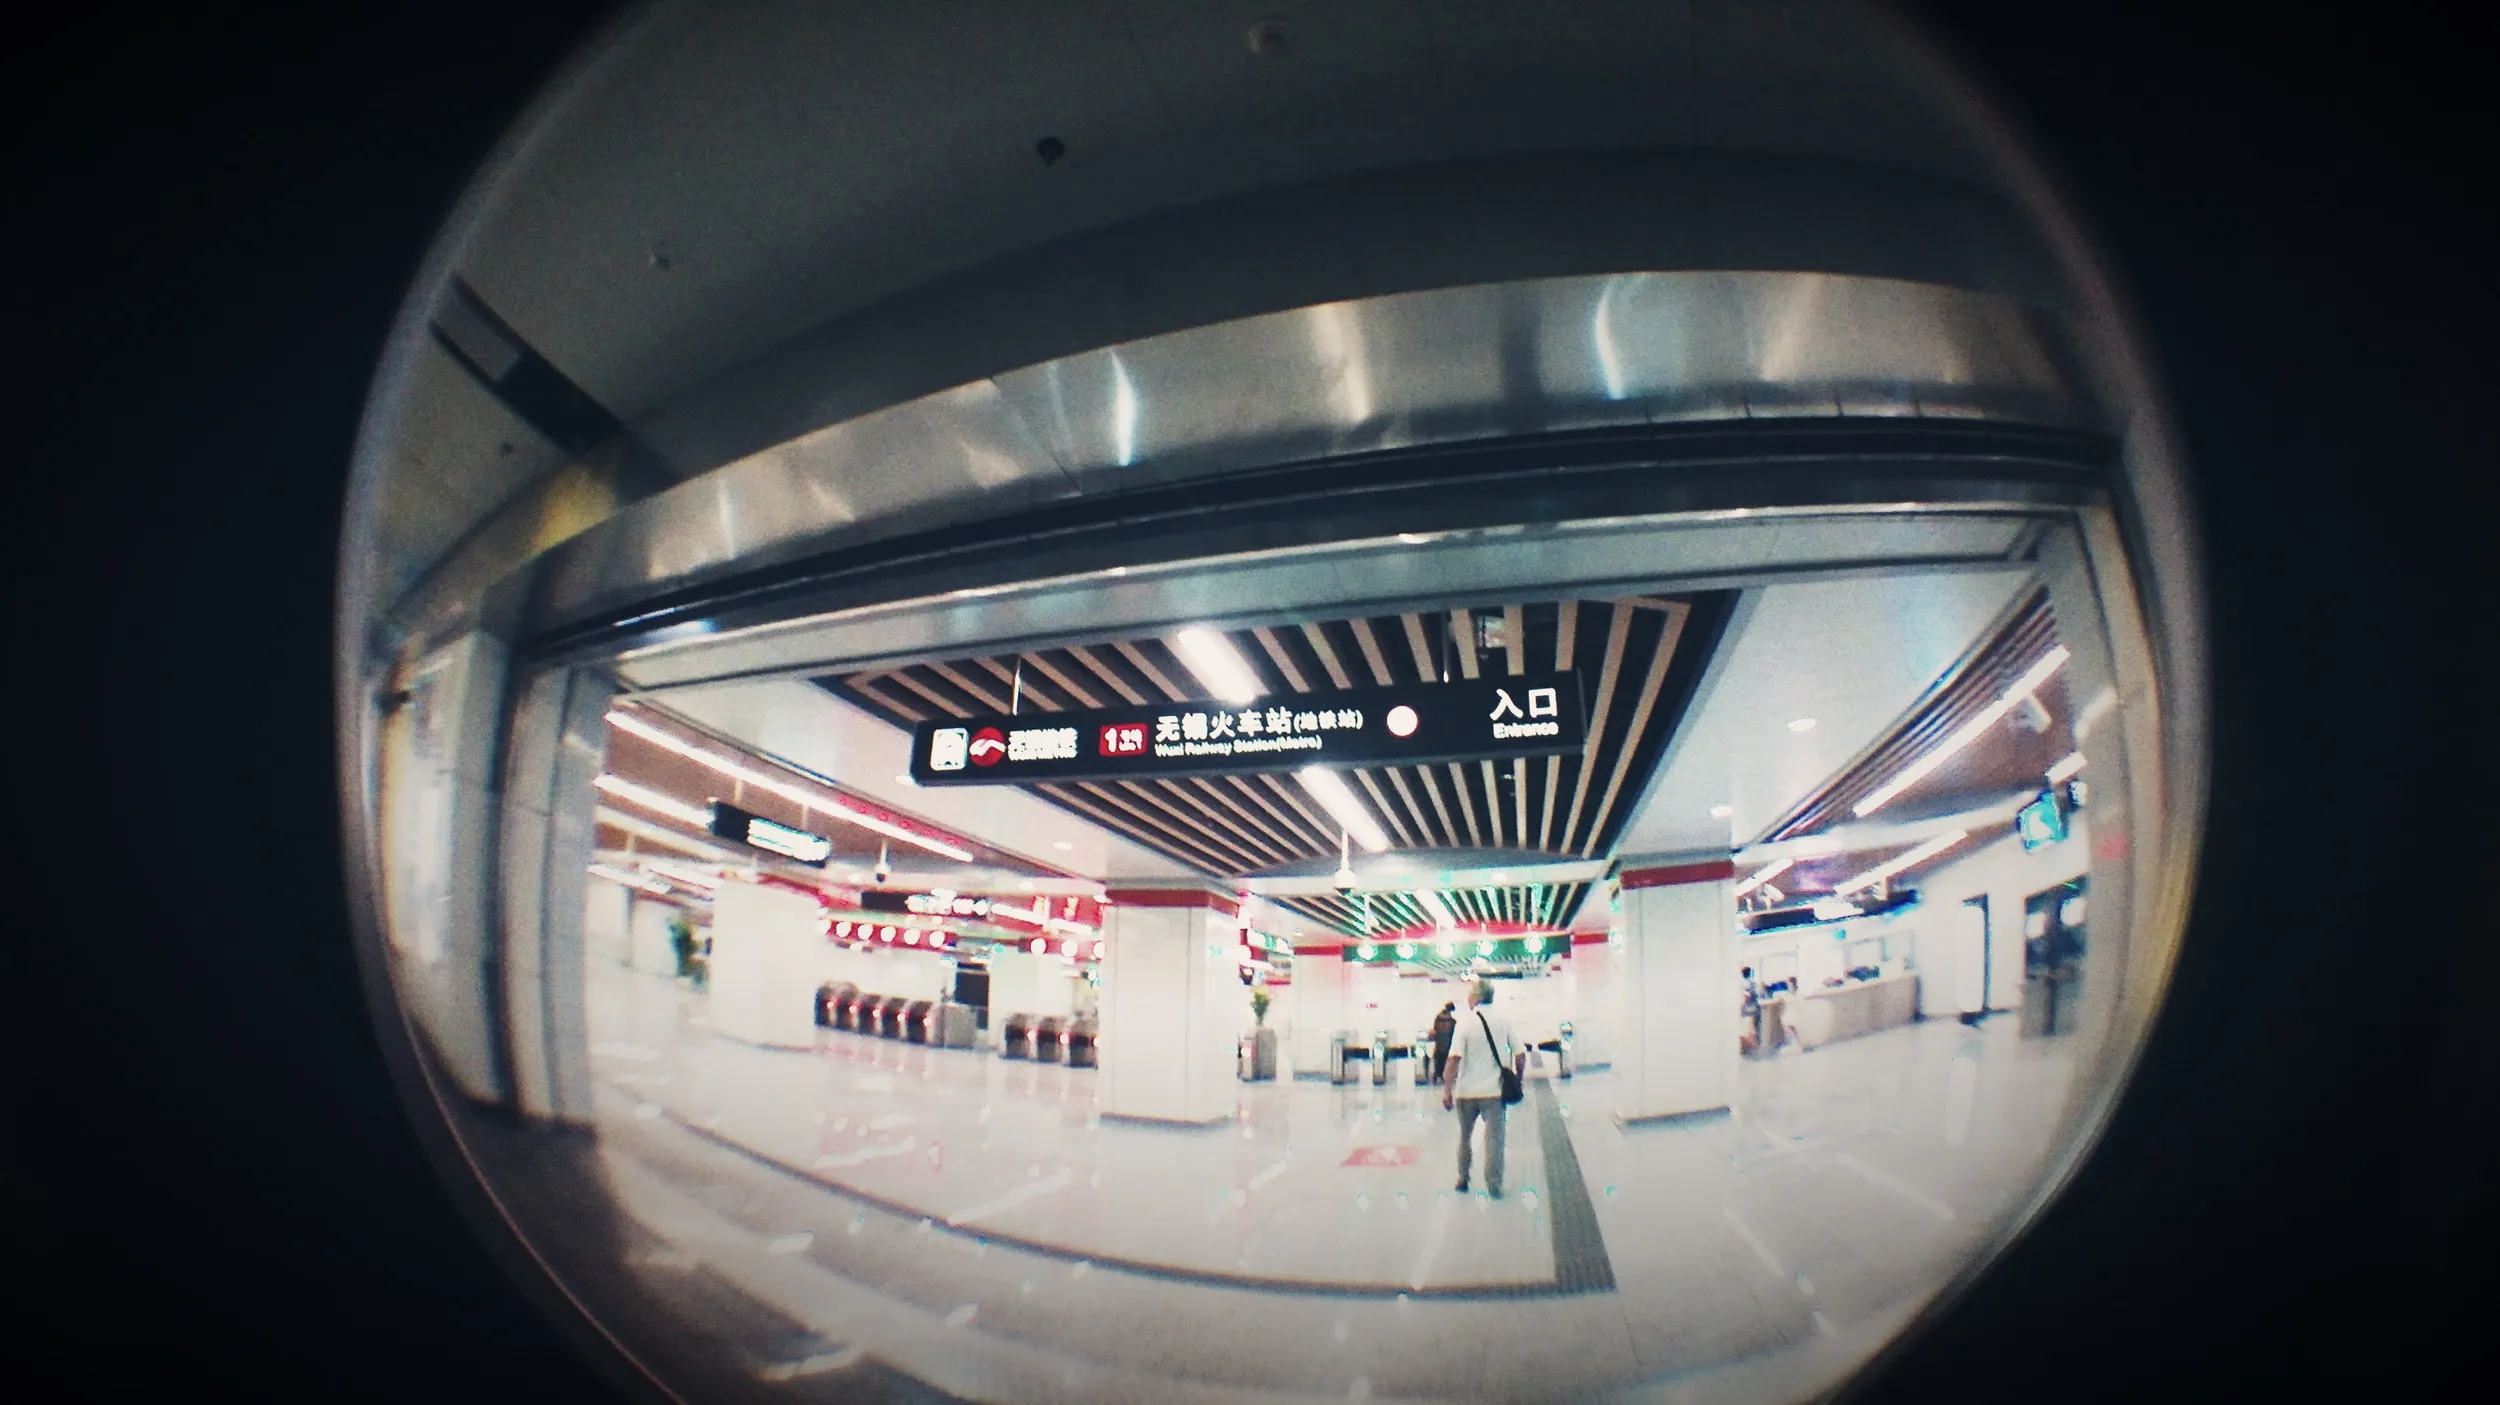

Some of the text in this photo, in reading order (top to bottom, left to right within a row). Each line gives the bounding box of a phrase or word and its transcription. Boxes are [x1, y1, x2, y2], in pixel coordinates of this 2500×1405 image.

[1489, 687, 1558, 721] 入口
[1492, 721, 1559, 739] Entrance
[1185, 741, 1233, 756] Railway
